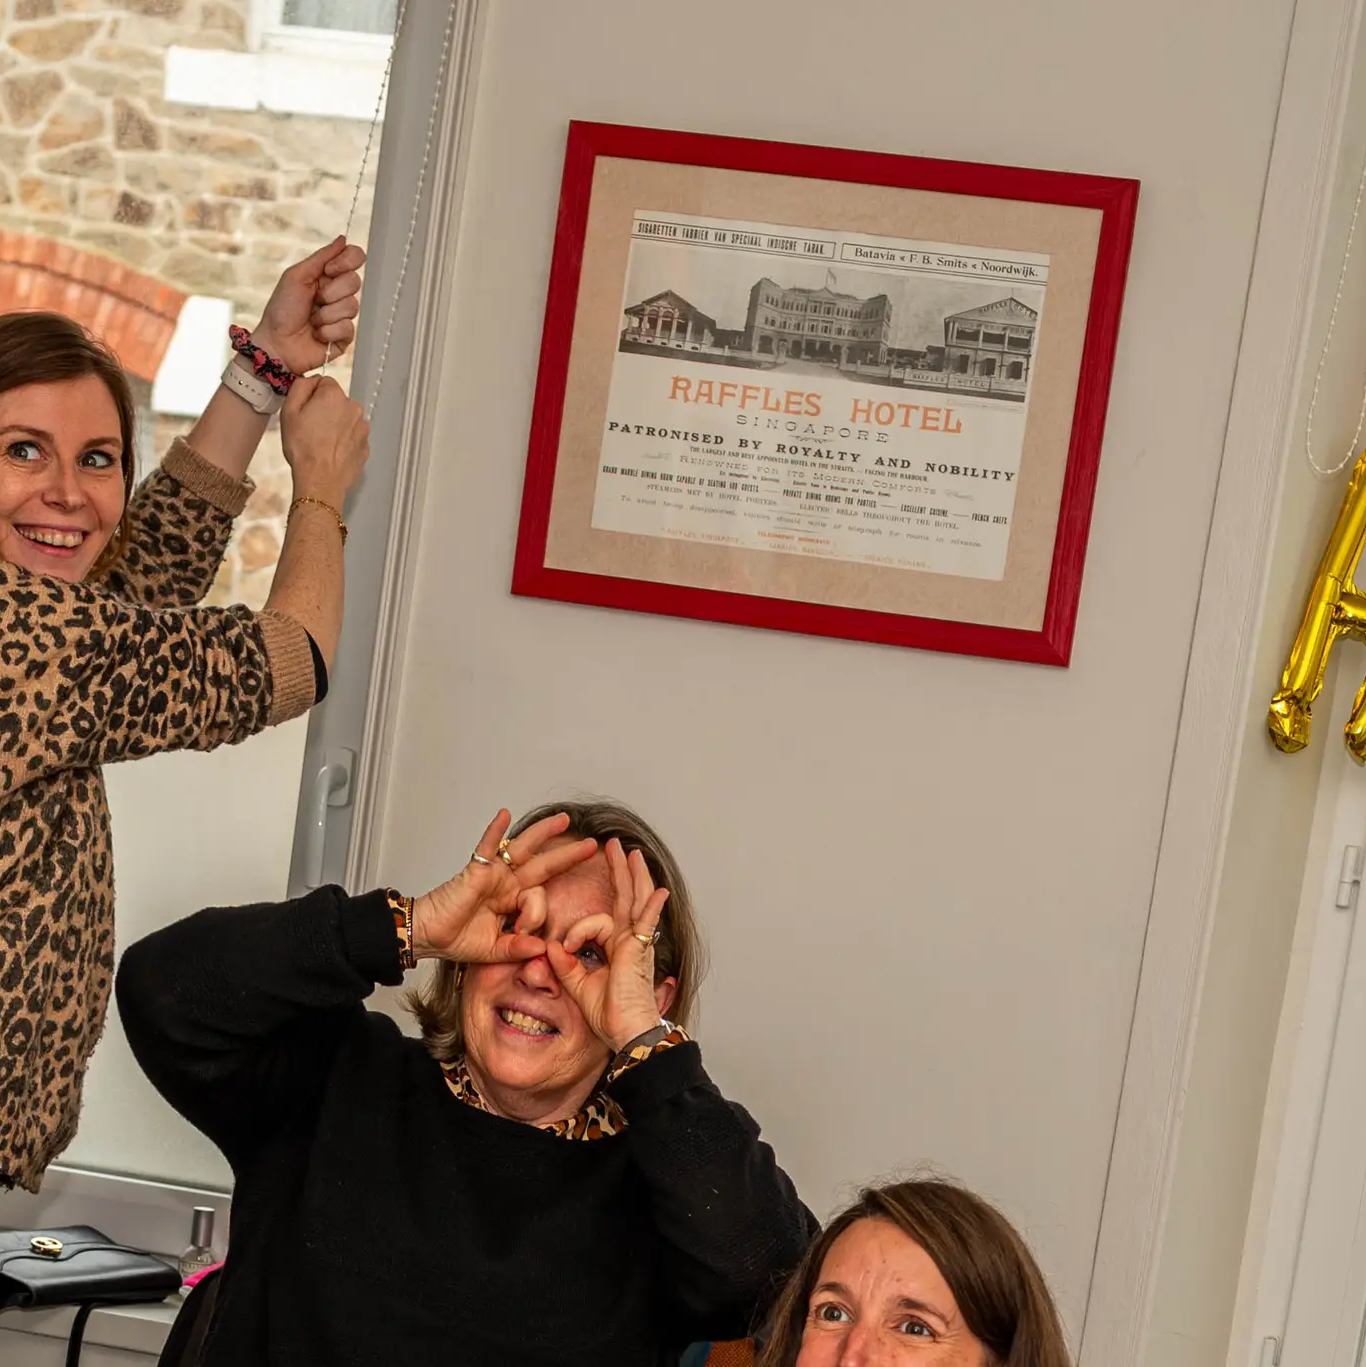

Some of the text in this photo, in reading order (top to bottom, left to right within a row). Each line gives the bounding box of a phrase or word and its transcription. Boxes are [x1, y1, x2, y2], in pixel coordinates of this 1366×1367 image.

[637, 222, 677, 236] SIGARETTEN
[681, 227, 709, 240] FABRIEK
[713, 231, 726, 242] VAN
[730, 233, 762, 247] SPECIAAL
[766, 237, 797, 251] INDISCHE
[853, 246, 896, 261] Batavia
[921, 254, 934, 265] B.
[935, 256, 969, 269] Smits
[980, 261, 1039, 279] Noordwijk.
[667, 374, 824, 418] RAFFLES
[848, 395, 965, 436] HOTEL
[734, 413, 890, 444] SINGAPORE
[607, 420, 1016, 483] PATRONISED BY ROYALTY AND NOBILITY
[689, 445, 700, 453] THE
[701, 447, 726, 456] LARGEST
[727, 450, 740, 458] AND
[740, 452, 756, 460] BEST
[756, 454, 789, 465] APPOINTED
[789, 458, 809, 467] HOTEL
[817, 462, 829, 470] THE
[863, 468, 886, 477] FACING
[886, 471, 898, 479] THE
[602, 465, 617, 474] GRAND
[619, 467, 638, 477] MARBLE
[640, 470, 657, 479] DINING
[659, 472, 674, 481] ROOM
[675, 474, 696, 484] CAPABLE
[706, 478, 727, 488] SEATING
[686, 488, 702, 496] MET
[718, 492, 742, 502] HOTEL
[782, 488, 802, 498] PRIVATE
[805, 491, 822, 501] DINING
[824, 494, 841, 503] ROOMS
[844, 496, 854, 505] FOR
[899, 503, 926, 514] EXCELLENT
[636, 496, 657, 505] avoid
[775, 514, 801, 525] should
[807, 519, 827, 528] write
[847, 524, 883, 537] telegraph
[905, 532, 930, 541] rooms
[835, 507, 858, 517] BELLS
[862, 510, 911, 524] THROUGHOUT
[914, 517, 930, 526] THE
[971, 512, 990, 522] FRENCH
